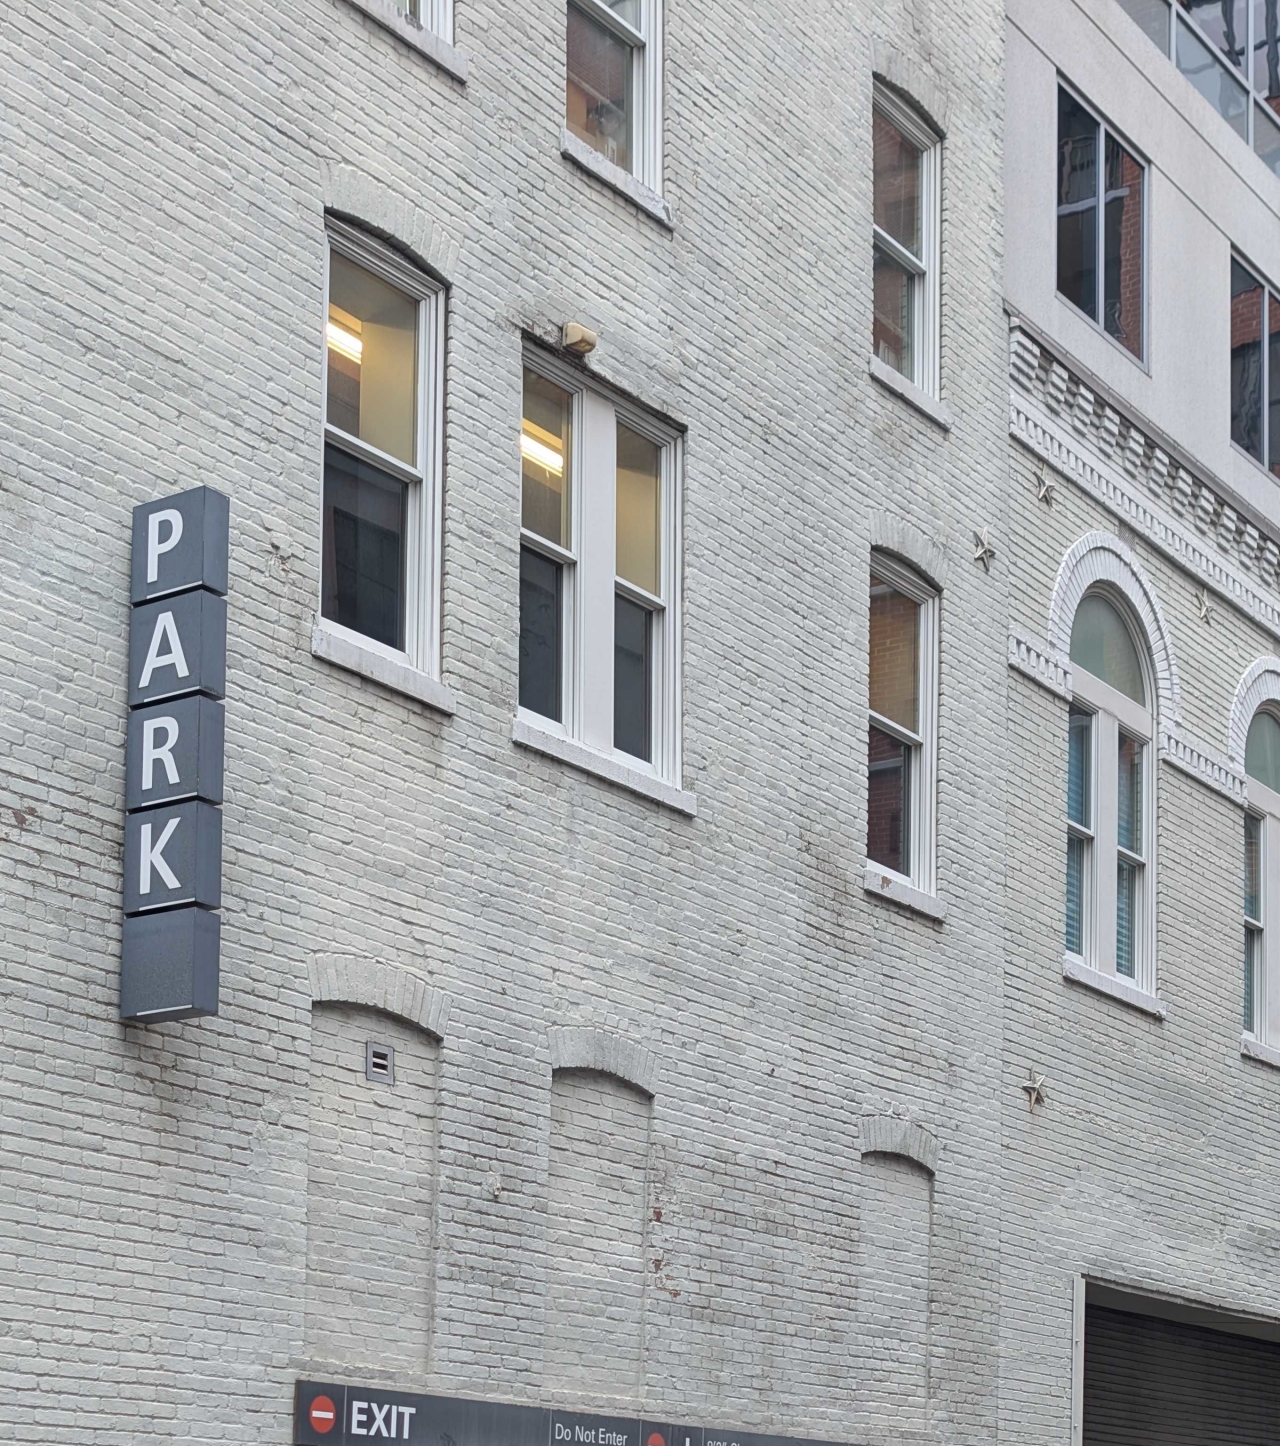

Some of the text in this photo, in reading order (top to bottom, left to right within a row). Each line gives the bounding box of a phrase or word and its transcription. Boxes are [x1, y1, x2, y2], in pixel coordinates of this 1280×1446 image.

[138, 507, 190, 896] PARK
[350, 1400, 416, 1439] EXIT
[554, 1423, 628, 1446] Do Not Enter
